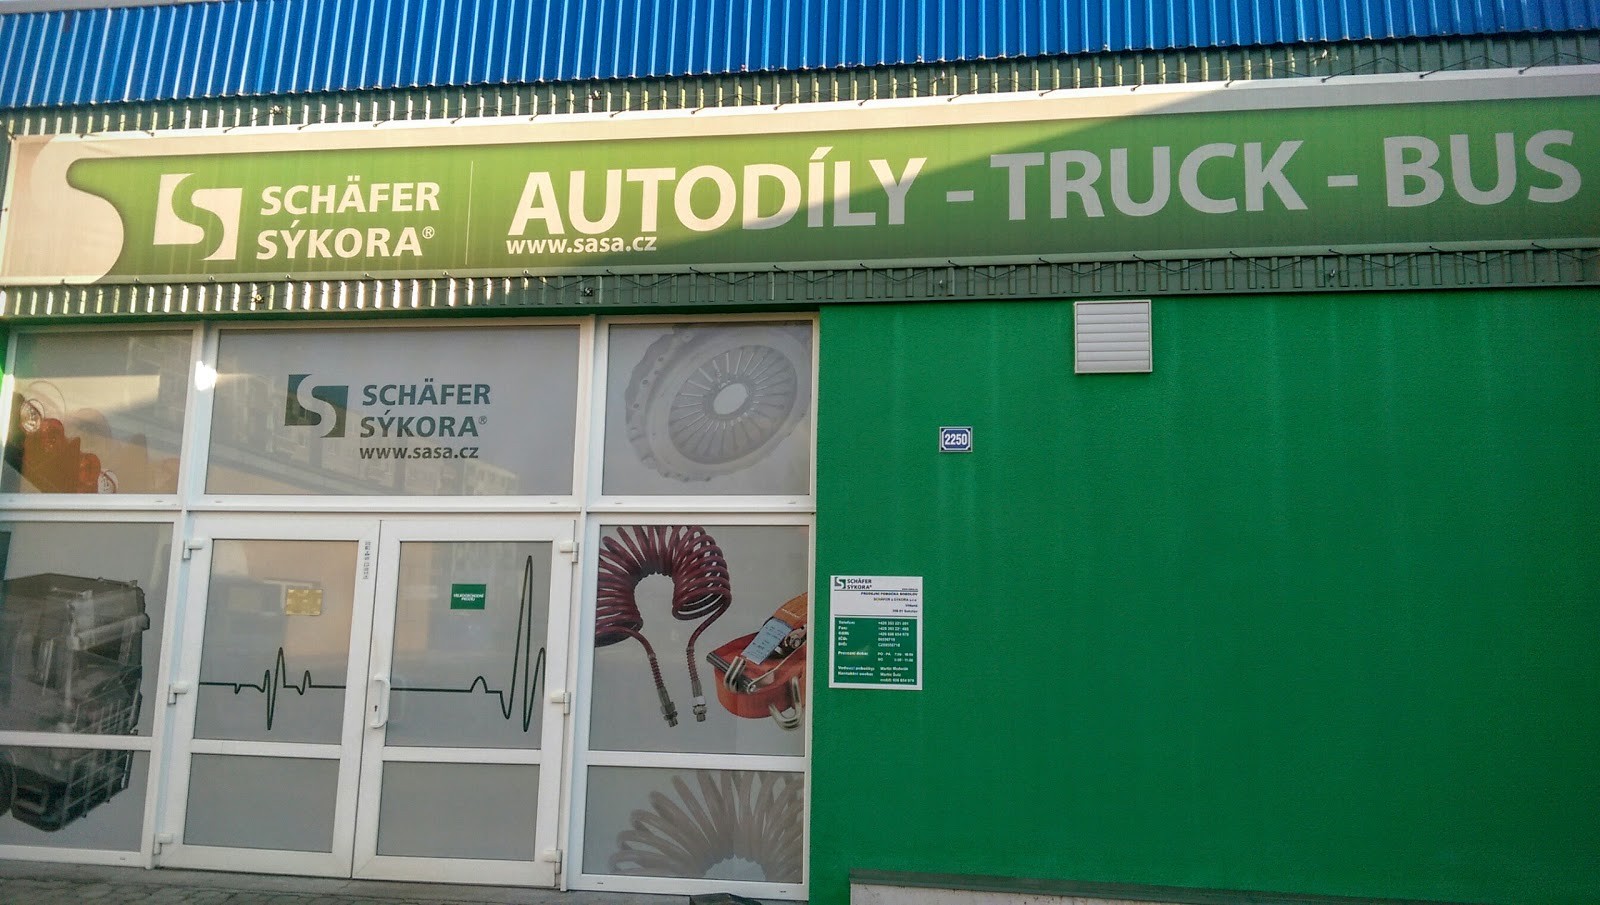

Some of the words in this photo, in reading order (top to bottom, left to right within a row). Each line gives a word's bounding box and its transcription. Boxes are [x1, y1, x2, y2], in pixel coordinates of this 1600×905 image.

[508, 146, 927, 236] AUTODÍLY
[990, 140, 1308, 221] TRUCK
[1384, 130, 1582, 208] BUS
[259, 175, 441, 216] SCHÄFER
[505, 234, 657, 255] www.sasa.cz
[362, 378, 491, 406] SCHÄFER
[944, 433, 968, 445] 2250
[359, 446, 479, 459] www.sasa.cz
